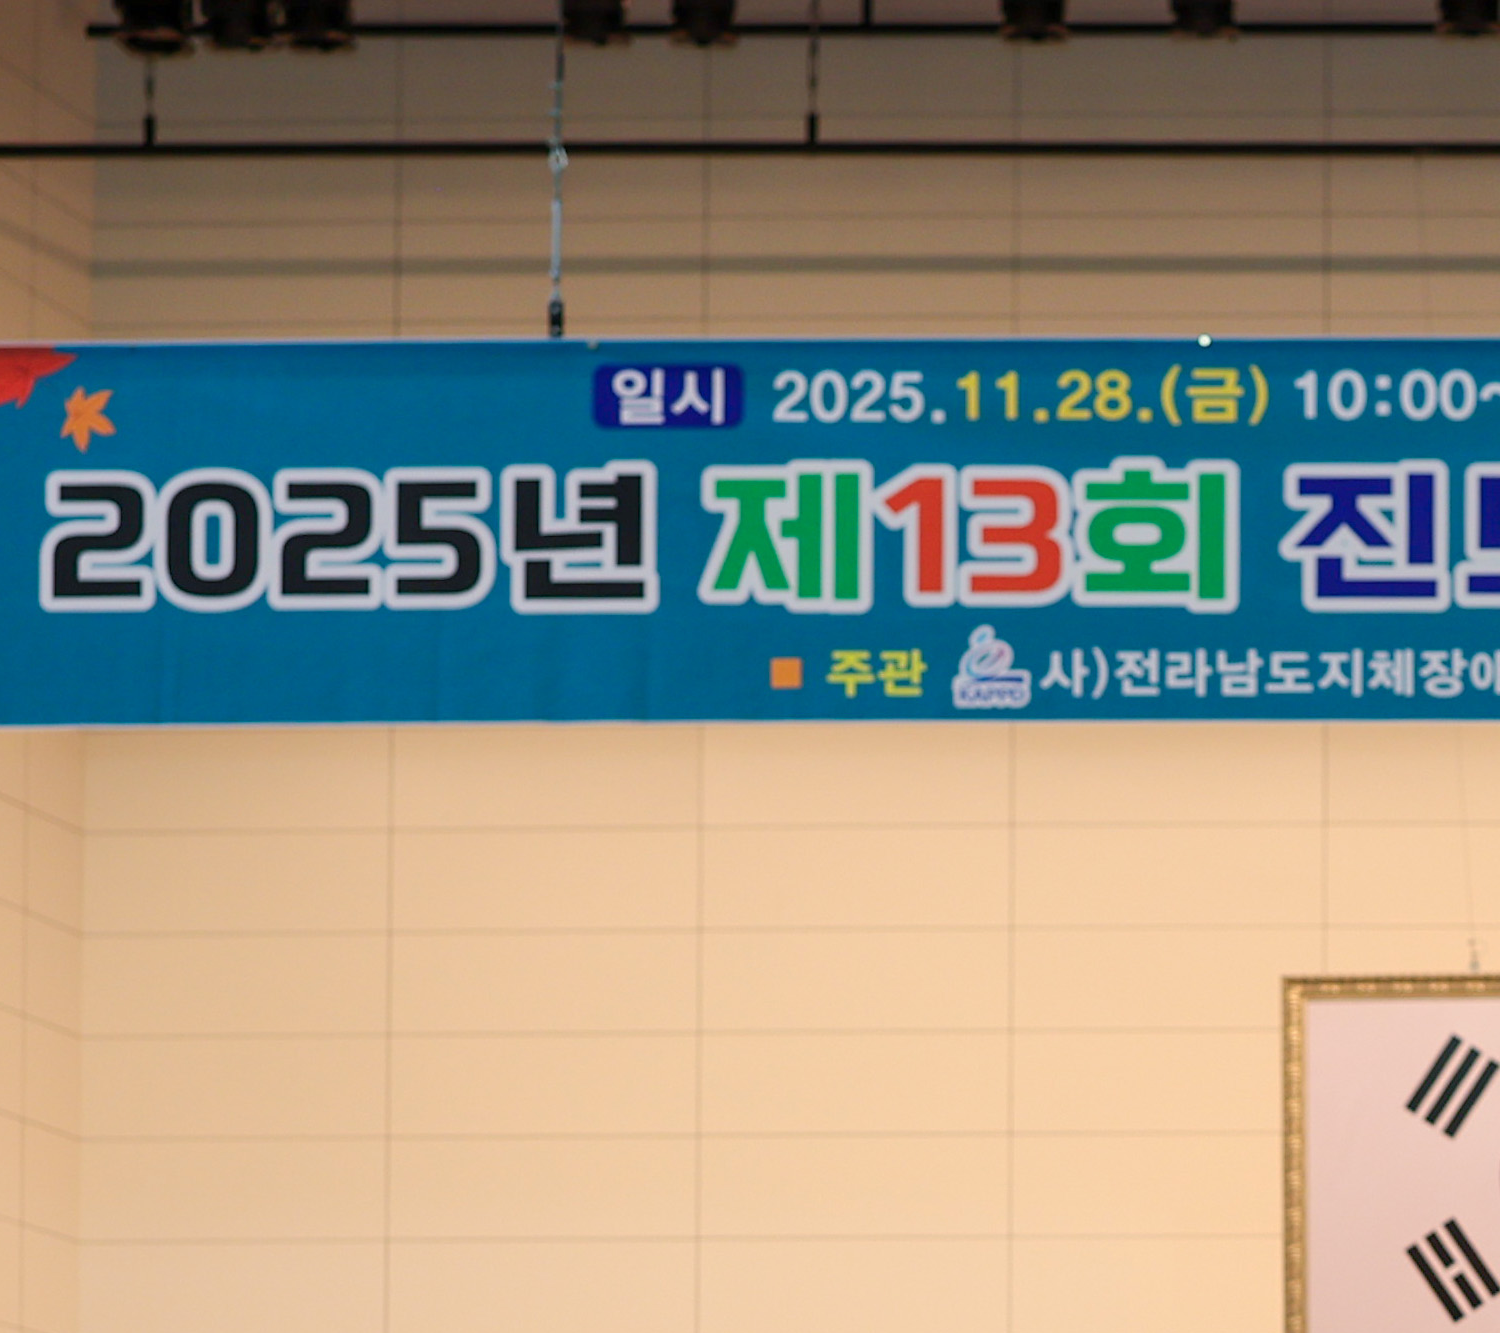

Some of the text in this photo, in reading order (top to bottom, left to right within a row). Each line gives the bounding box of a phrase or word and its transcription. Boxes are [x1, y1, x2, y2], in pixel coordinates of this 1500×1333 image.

[612, 370, 726, 426] 일시
[773, 367, 1270, 425] 2025.11.28.(금)
[48, 470, 652, 606] 2025년
[708, 466, 1230, 604] 제13회
[824, 647, 926, 698] 주관
